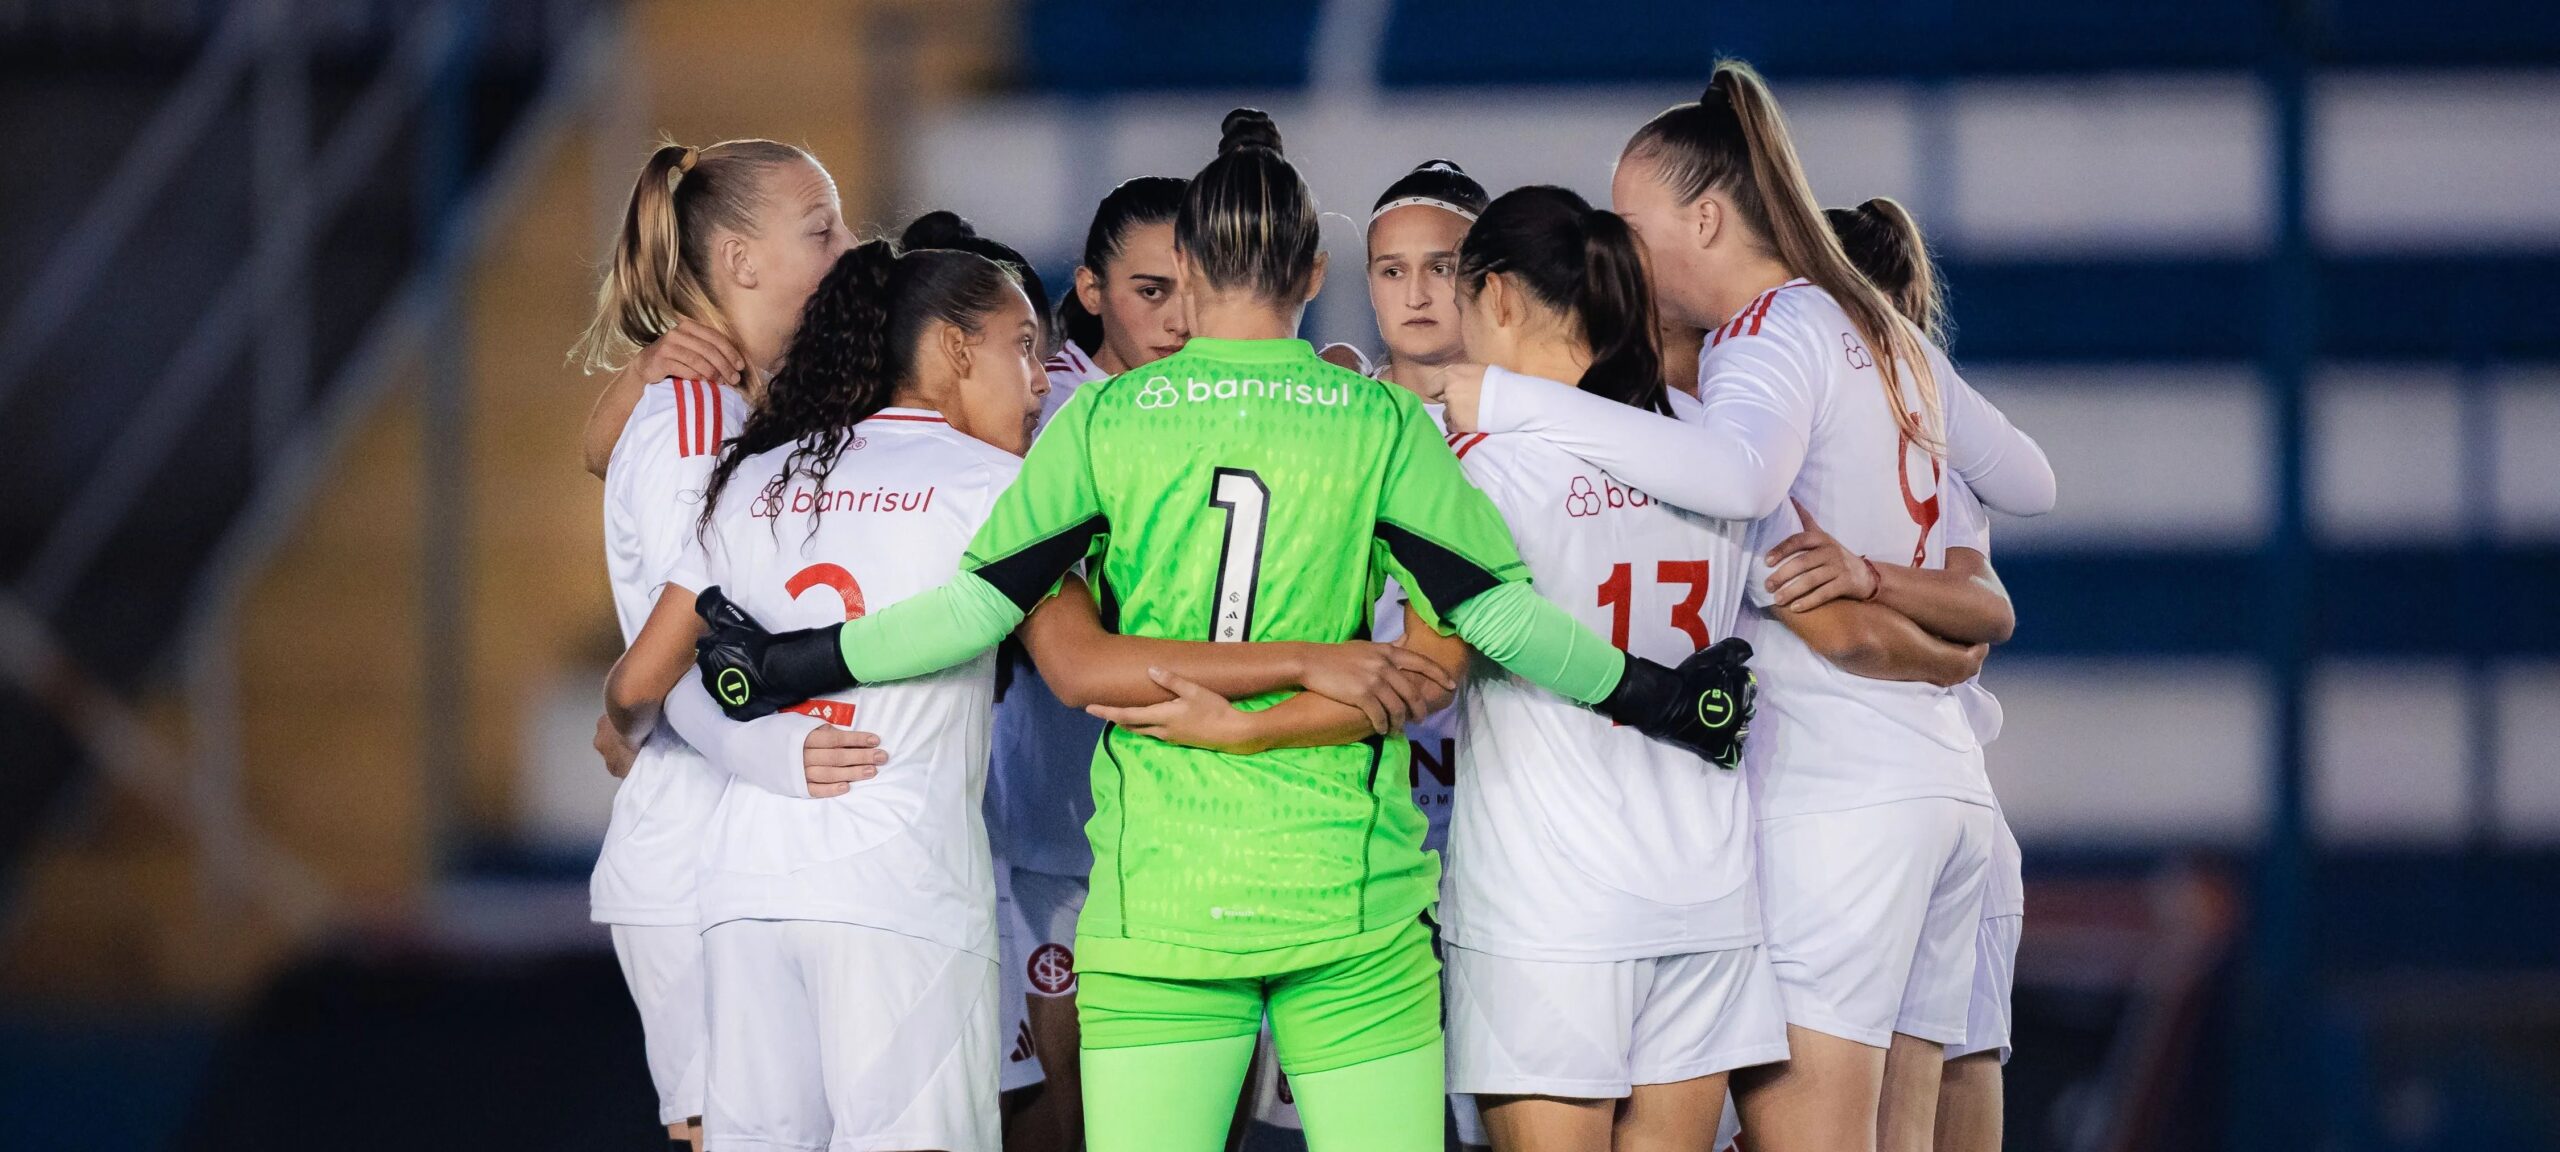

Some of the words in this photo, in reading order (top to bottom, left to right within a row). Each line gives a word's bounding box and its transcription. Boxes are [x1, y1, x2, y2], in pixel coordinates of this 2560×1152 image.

[1187, 377, 1348, 406] banrisul
[791, 486, 934, 512] banrisul
[1208, 466, 1271, 642] 1
